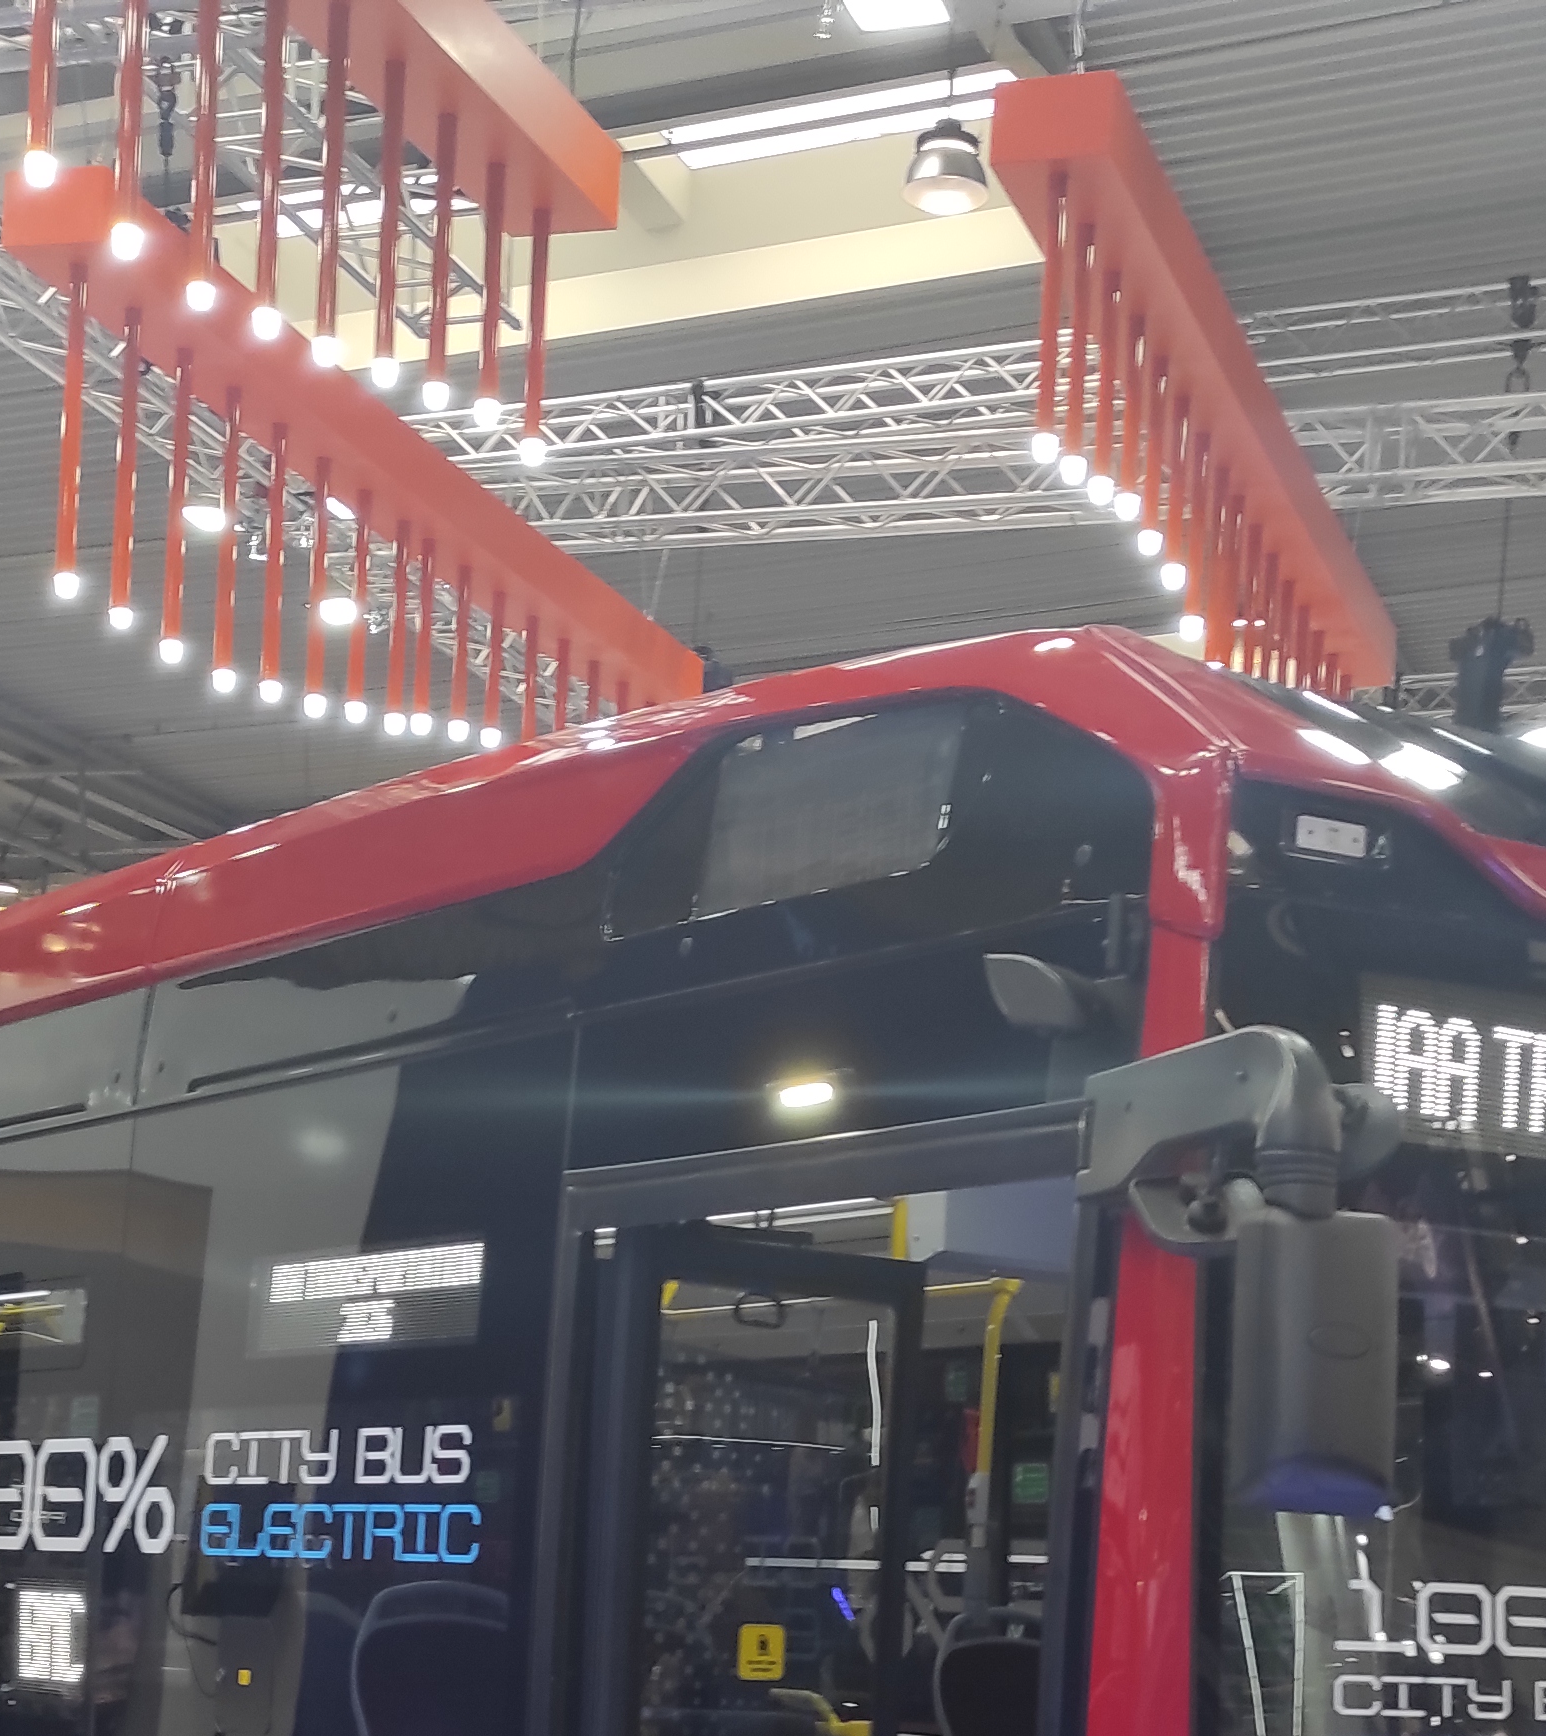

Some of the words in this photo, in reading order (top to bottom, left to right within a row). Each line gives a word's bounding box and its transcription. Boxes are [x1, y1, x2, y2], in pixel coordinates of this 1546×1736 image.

[1373, 1004, 1483, 1122] IAA
[204, 1428, 340, 1485] CITY
[354, 1425, 473, 1484] BUS
[199, 1502, 482, 1563] ELECTRIC
[1333, 1674, 1513, 1721] CITY
